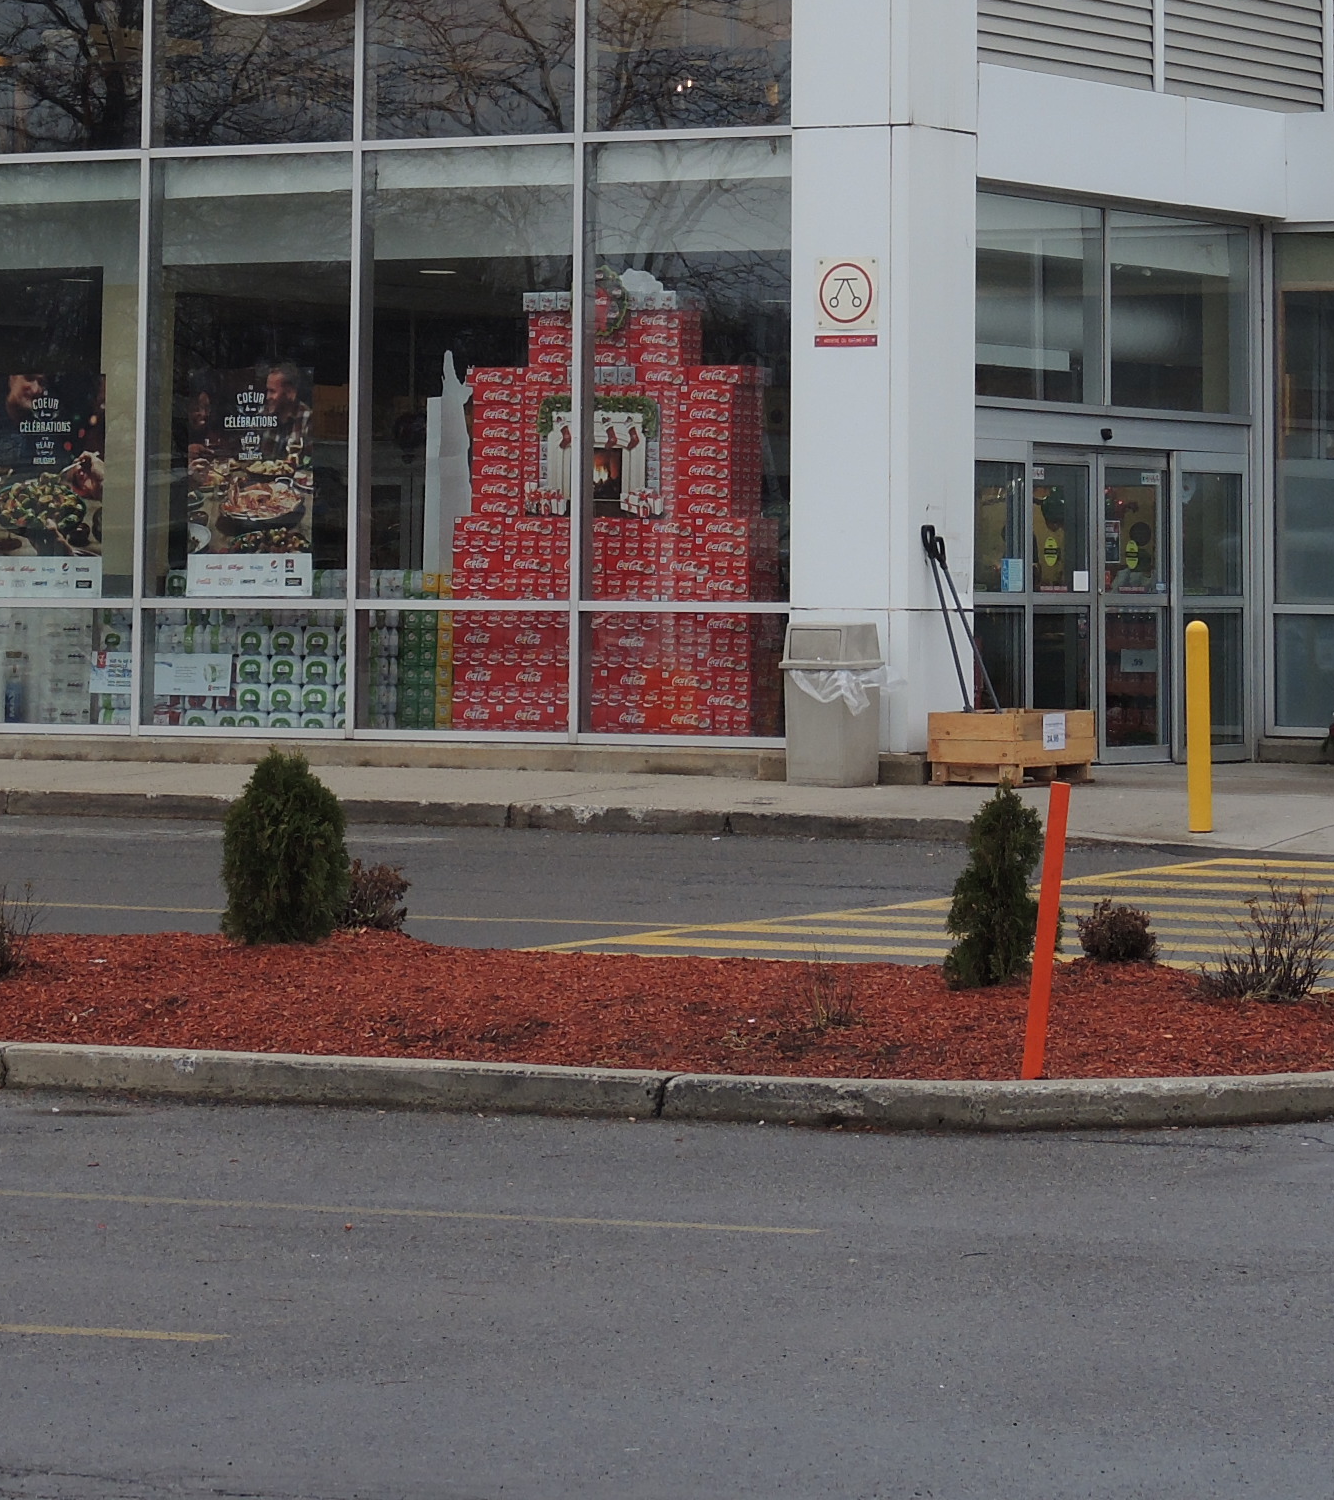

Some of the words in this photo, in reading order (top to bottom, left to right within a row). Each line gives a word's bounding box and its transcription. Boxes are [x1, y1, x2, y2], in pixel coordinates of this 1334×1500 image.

[33, 397, 59, 410] COEUR
[237, 392, 265, 404] COEUR
[224, 414, 277, 428] CÉLÉBRATIONS
